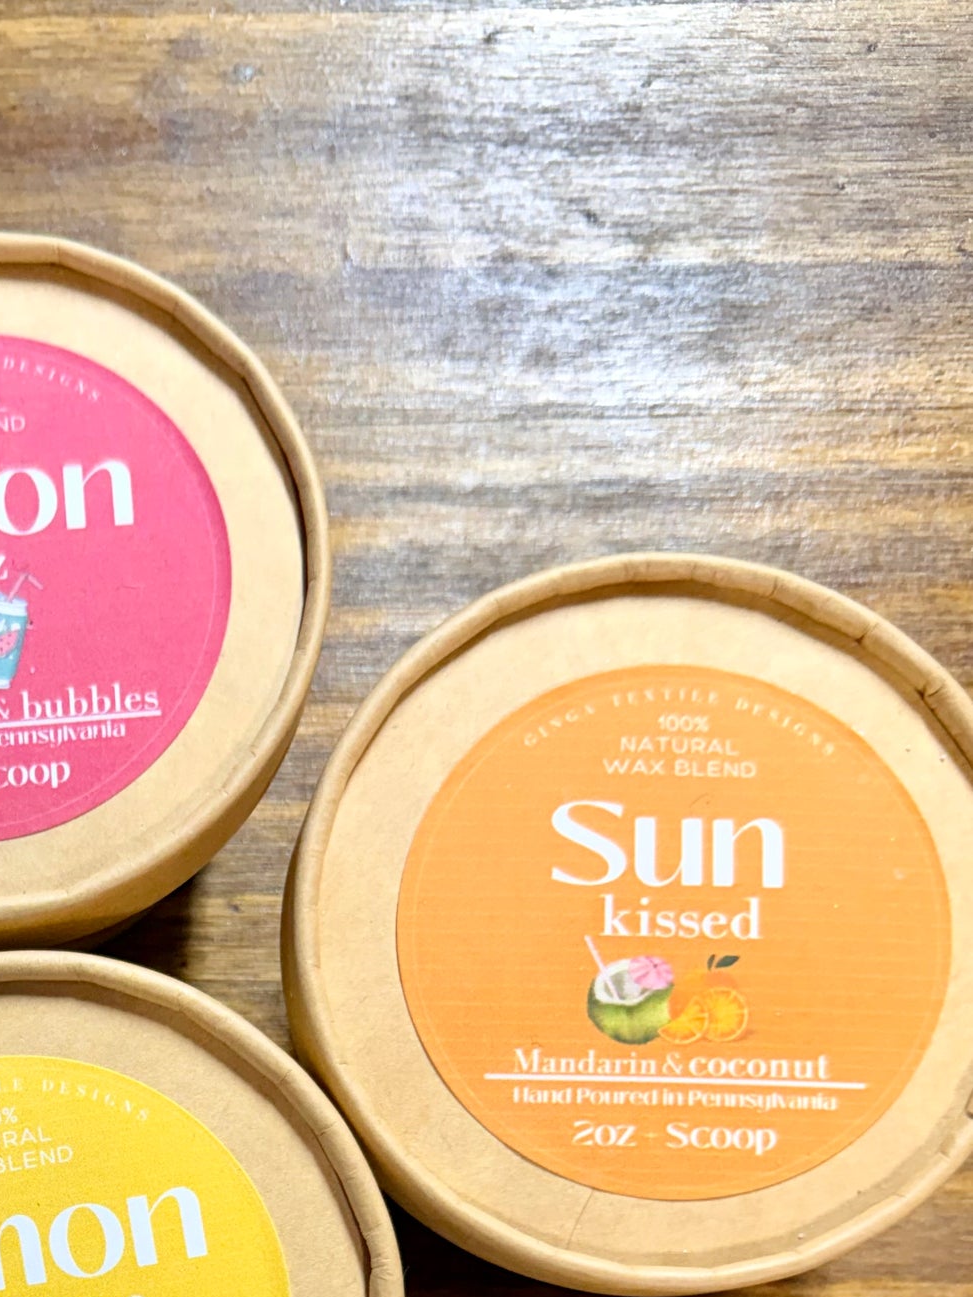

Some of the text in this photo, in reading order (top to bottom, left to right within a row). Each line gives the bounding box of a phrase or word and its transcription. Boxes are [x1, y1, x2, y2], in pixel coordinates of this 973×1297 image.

[3, 354, 102, 402] DESIGNS
[21, 682, 160, 721] bubbles
[612, 688, 720, 708] TEXTILE
[735, 697, 835, 756] DESIGNS
[658, 714, 709, 732] 100%
[620, 736, 739, 755] NATURAL
[603, 759, 757, 779] WAX BLEND
[550, 801, 783, 888] Sun
[600, 894, 762, 939] kissed
[513, 1048, 832, 1079] Mandarin & coconut
[42, 1080, 149, 1121] DESIGNS
[512, 1086, 837, 1113] Hand Poured in Pennsylvania
[573, 1120, 777, 1155] 2oz Scoop
